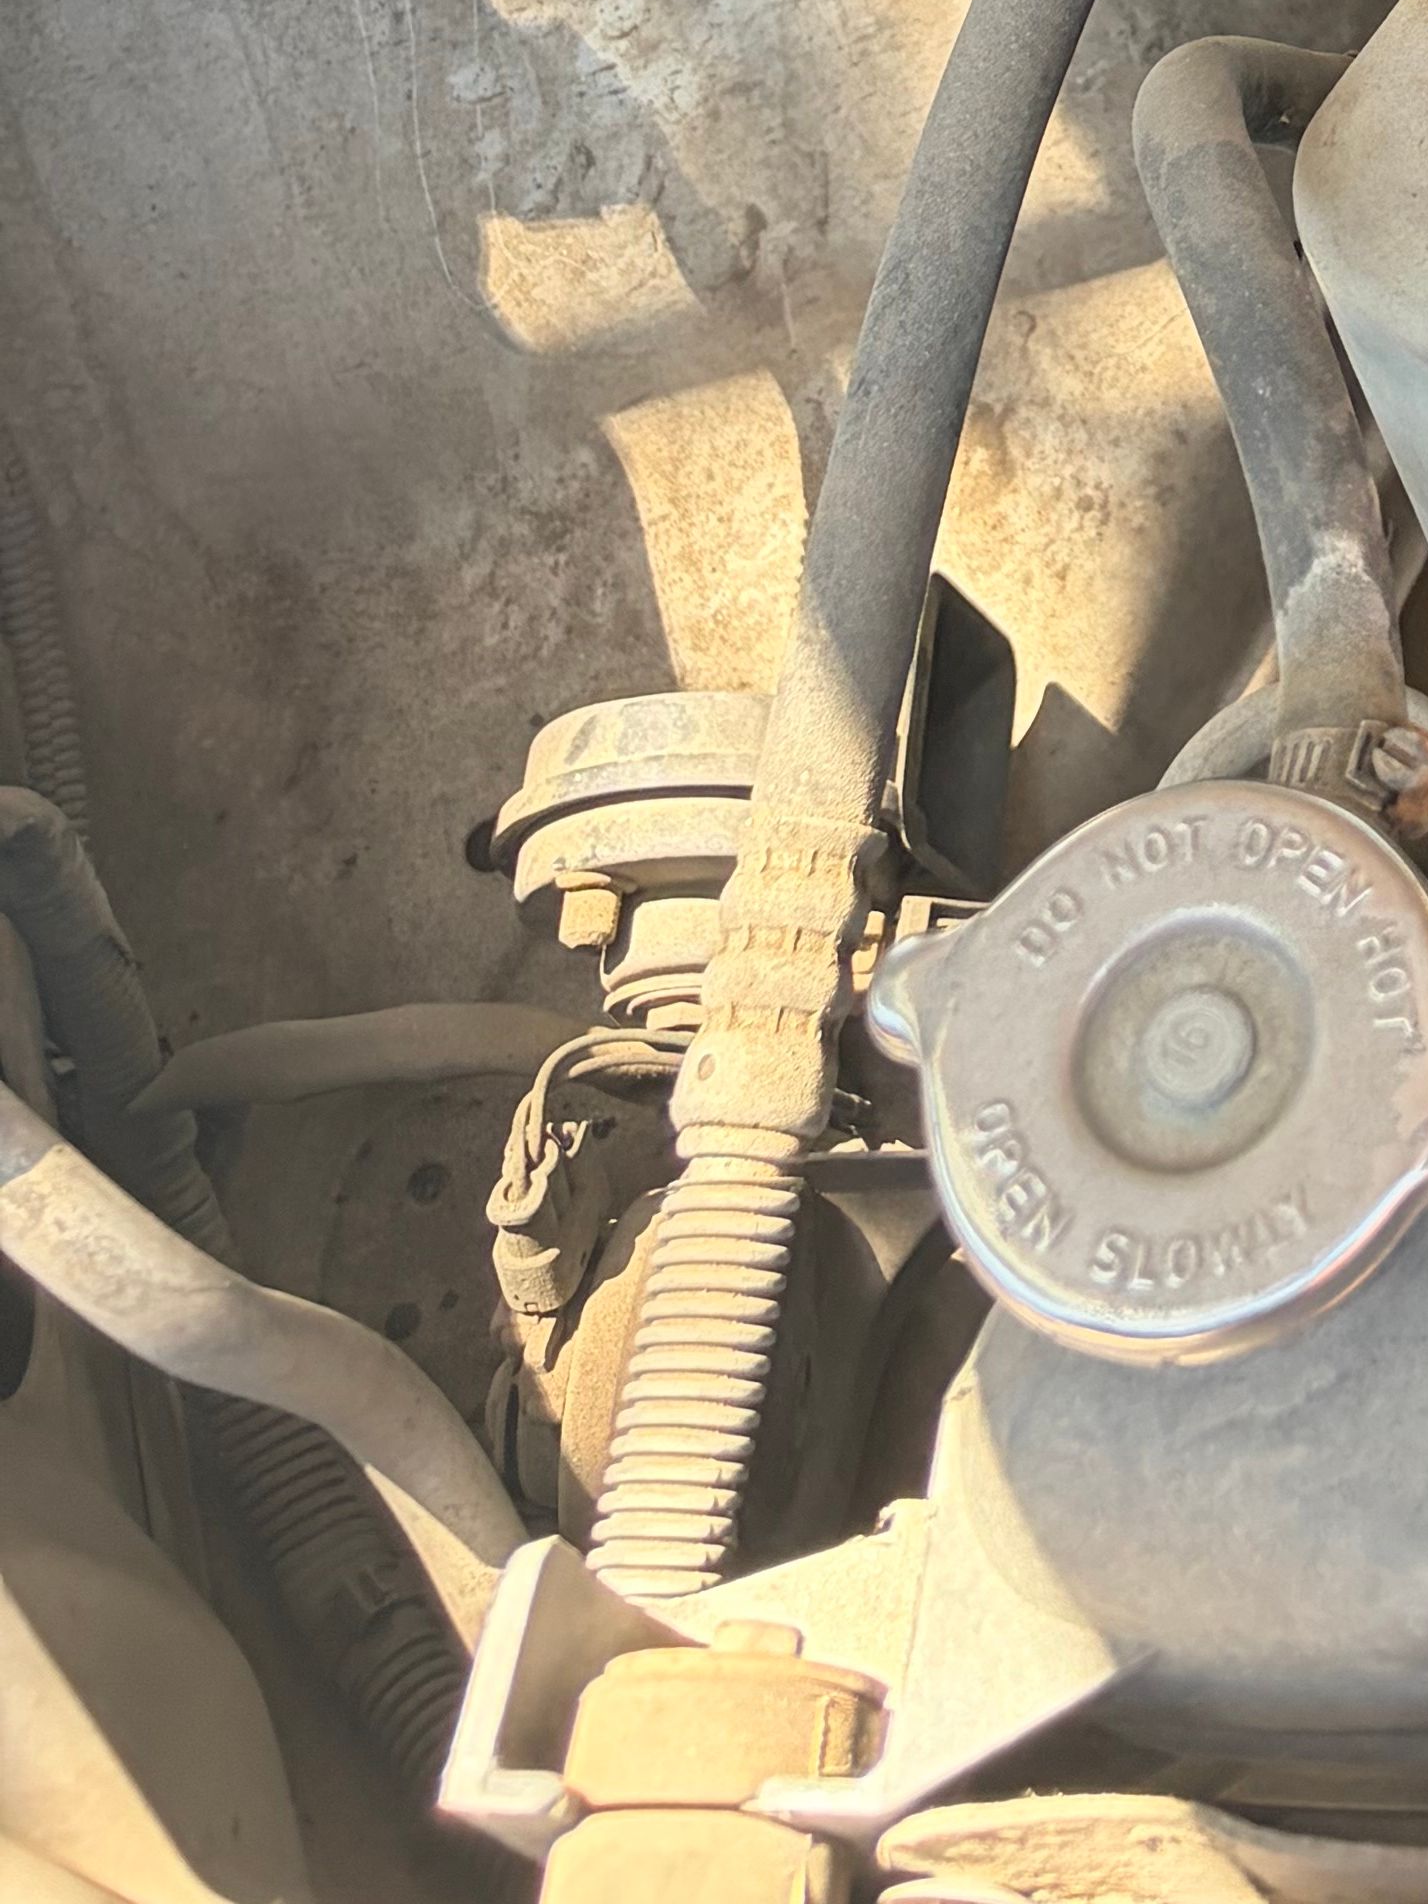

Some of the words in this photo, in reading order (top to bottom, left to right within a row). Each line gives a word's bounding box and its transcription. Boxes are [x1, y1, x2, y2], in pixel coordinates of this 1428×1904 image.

[1016, 886, 1084, 969] DO
[1100, 814, 1208, 889] NOT
[1237, 816, 1374, 918] OPEN
[1355, 917, 1420, 1040] HOT
[975, 1101, 1079, 1254] OPEN
[1089, 1189, 1312, 1291] SLOWLY
